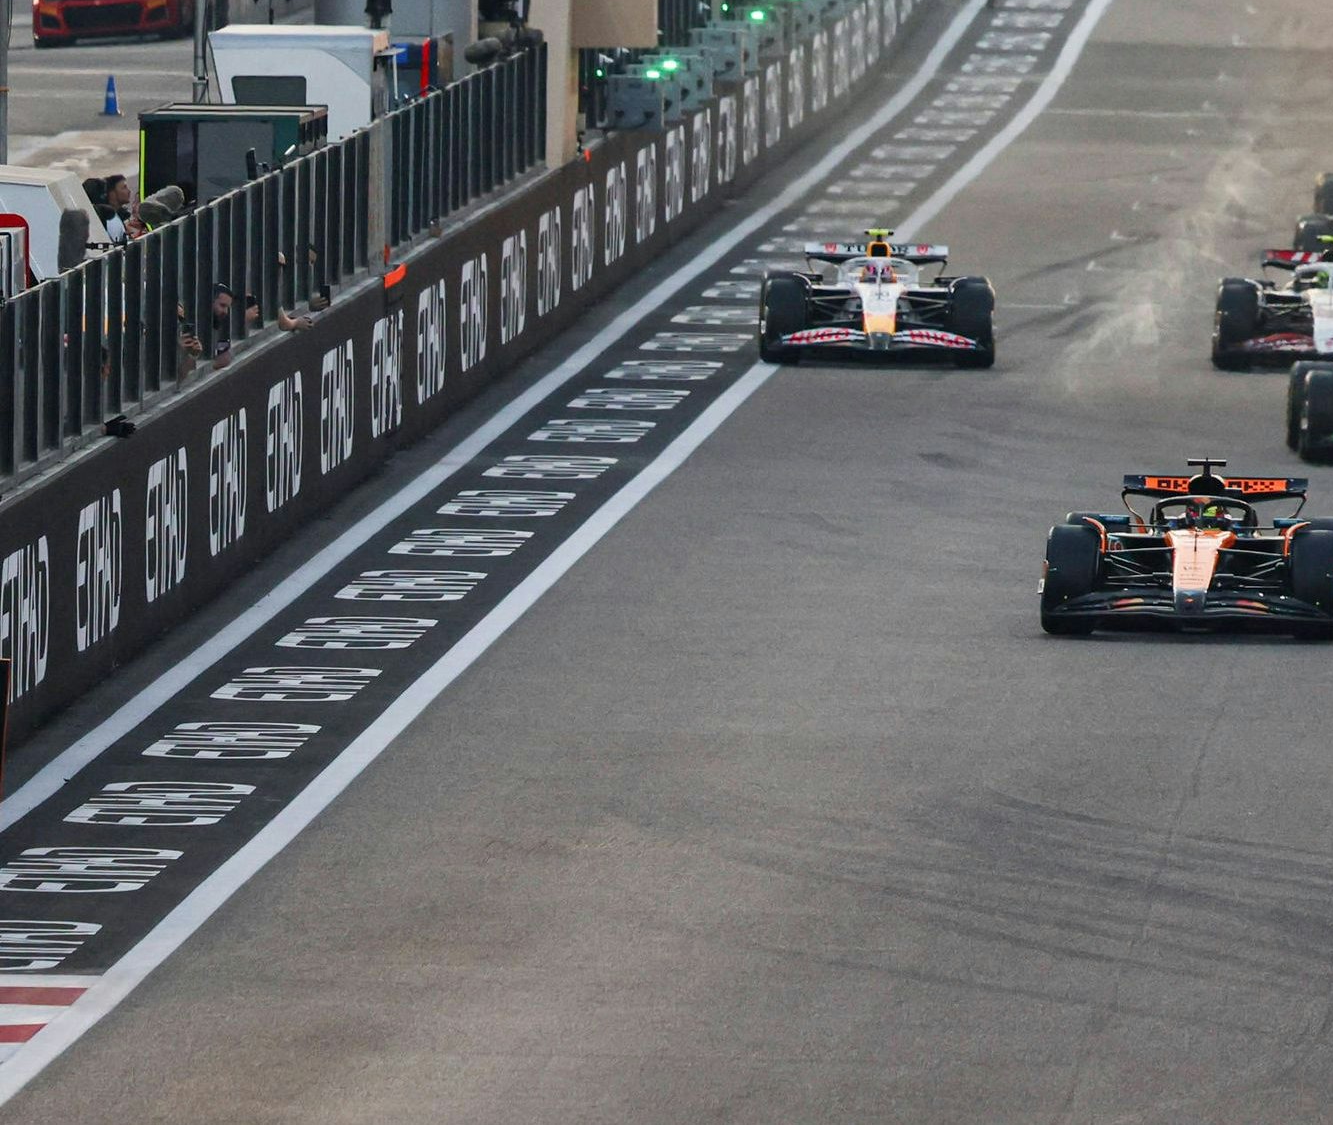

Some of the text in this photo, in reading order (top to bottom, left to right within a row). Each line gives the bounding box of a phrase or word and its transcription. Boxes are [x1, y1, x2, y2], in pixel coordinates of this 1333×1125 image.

[416, 279, 445, 405] ETIHAD
[460, 253, 488, 372] ETIHAD
[266, 371, 302, 512] ETIHAD
[320, 339, 353, 474] ETIHAD
[145, 446, 188, 602] ETIHAD
[209, 407, 247, 556] ETIHAD
[76, 488, 122, 652] ETIHAD
